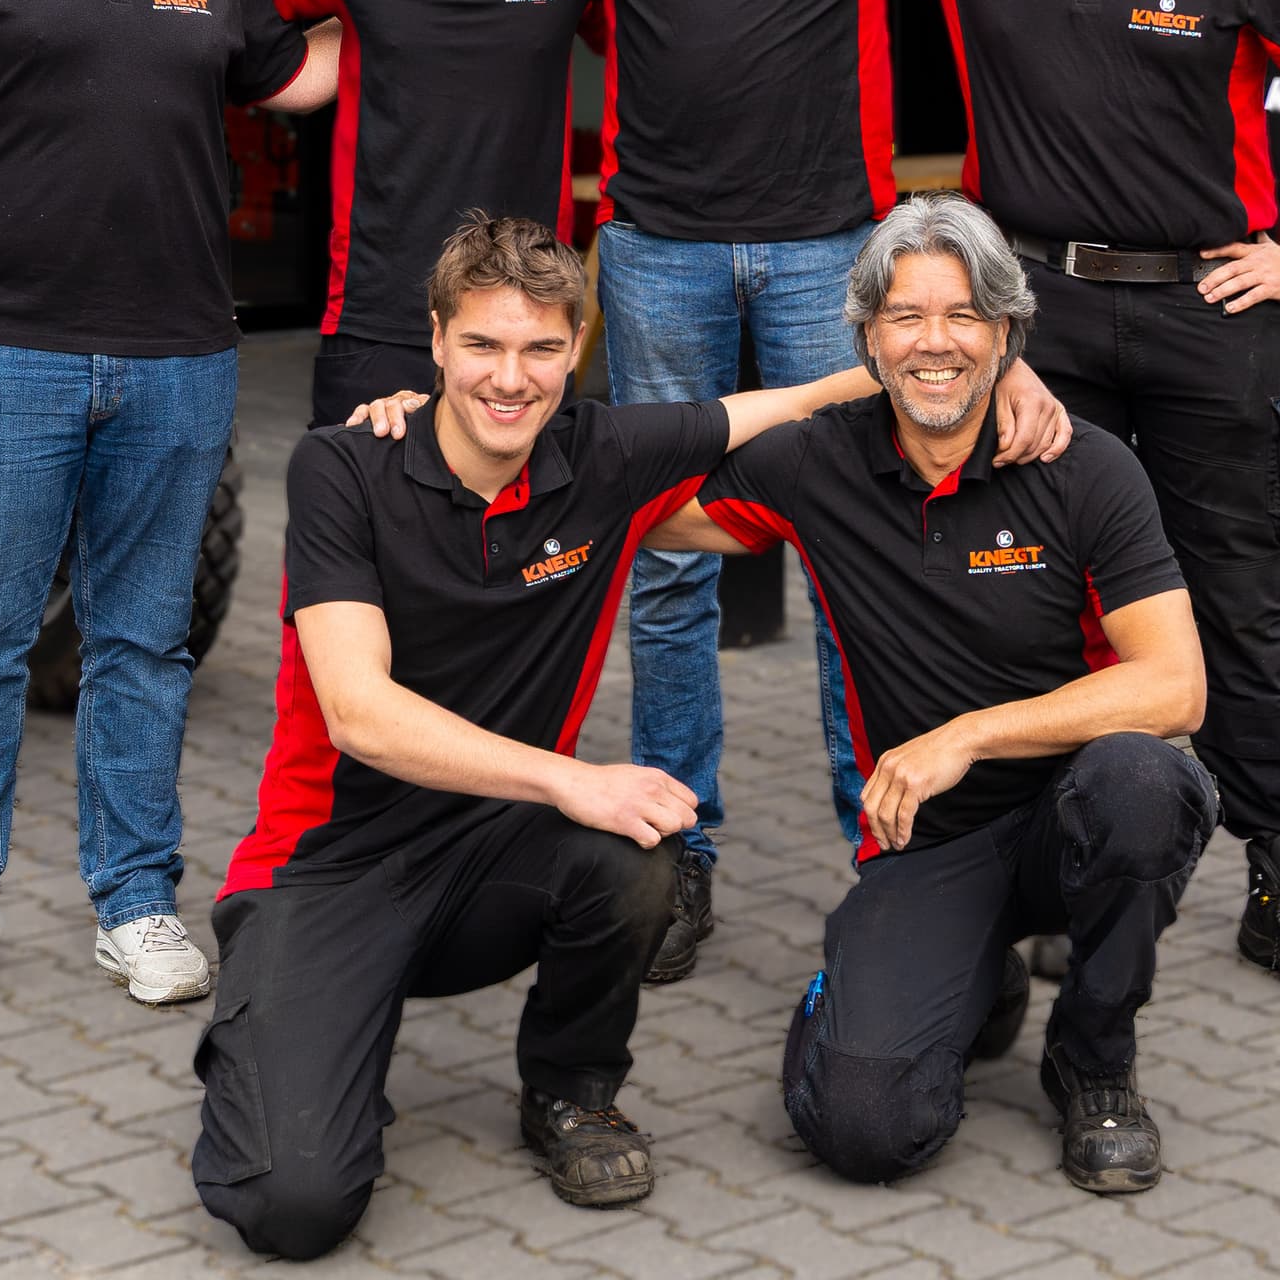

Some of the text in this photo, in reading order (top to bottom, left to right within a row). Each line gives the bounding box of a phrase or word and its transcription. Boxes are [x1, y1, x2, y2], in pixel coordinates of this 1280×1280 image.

[1130, 8, 1200, 31] KNEGT
[521, 544, 590, 583] KNEGT
[968, 545, 1042, 568] KNEGT
[994, 564, 1024, 573] TRACTORS
